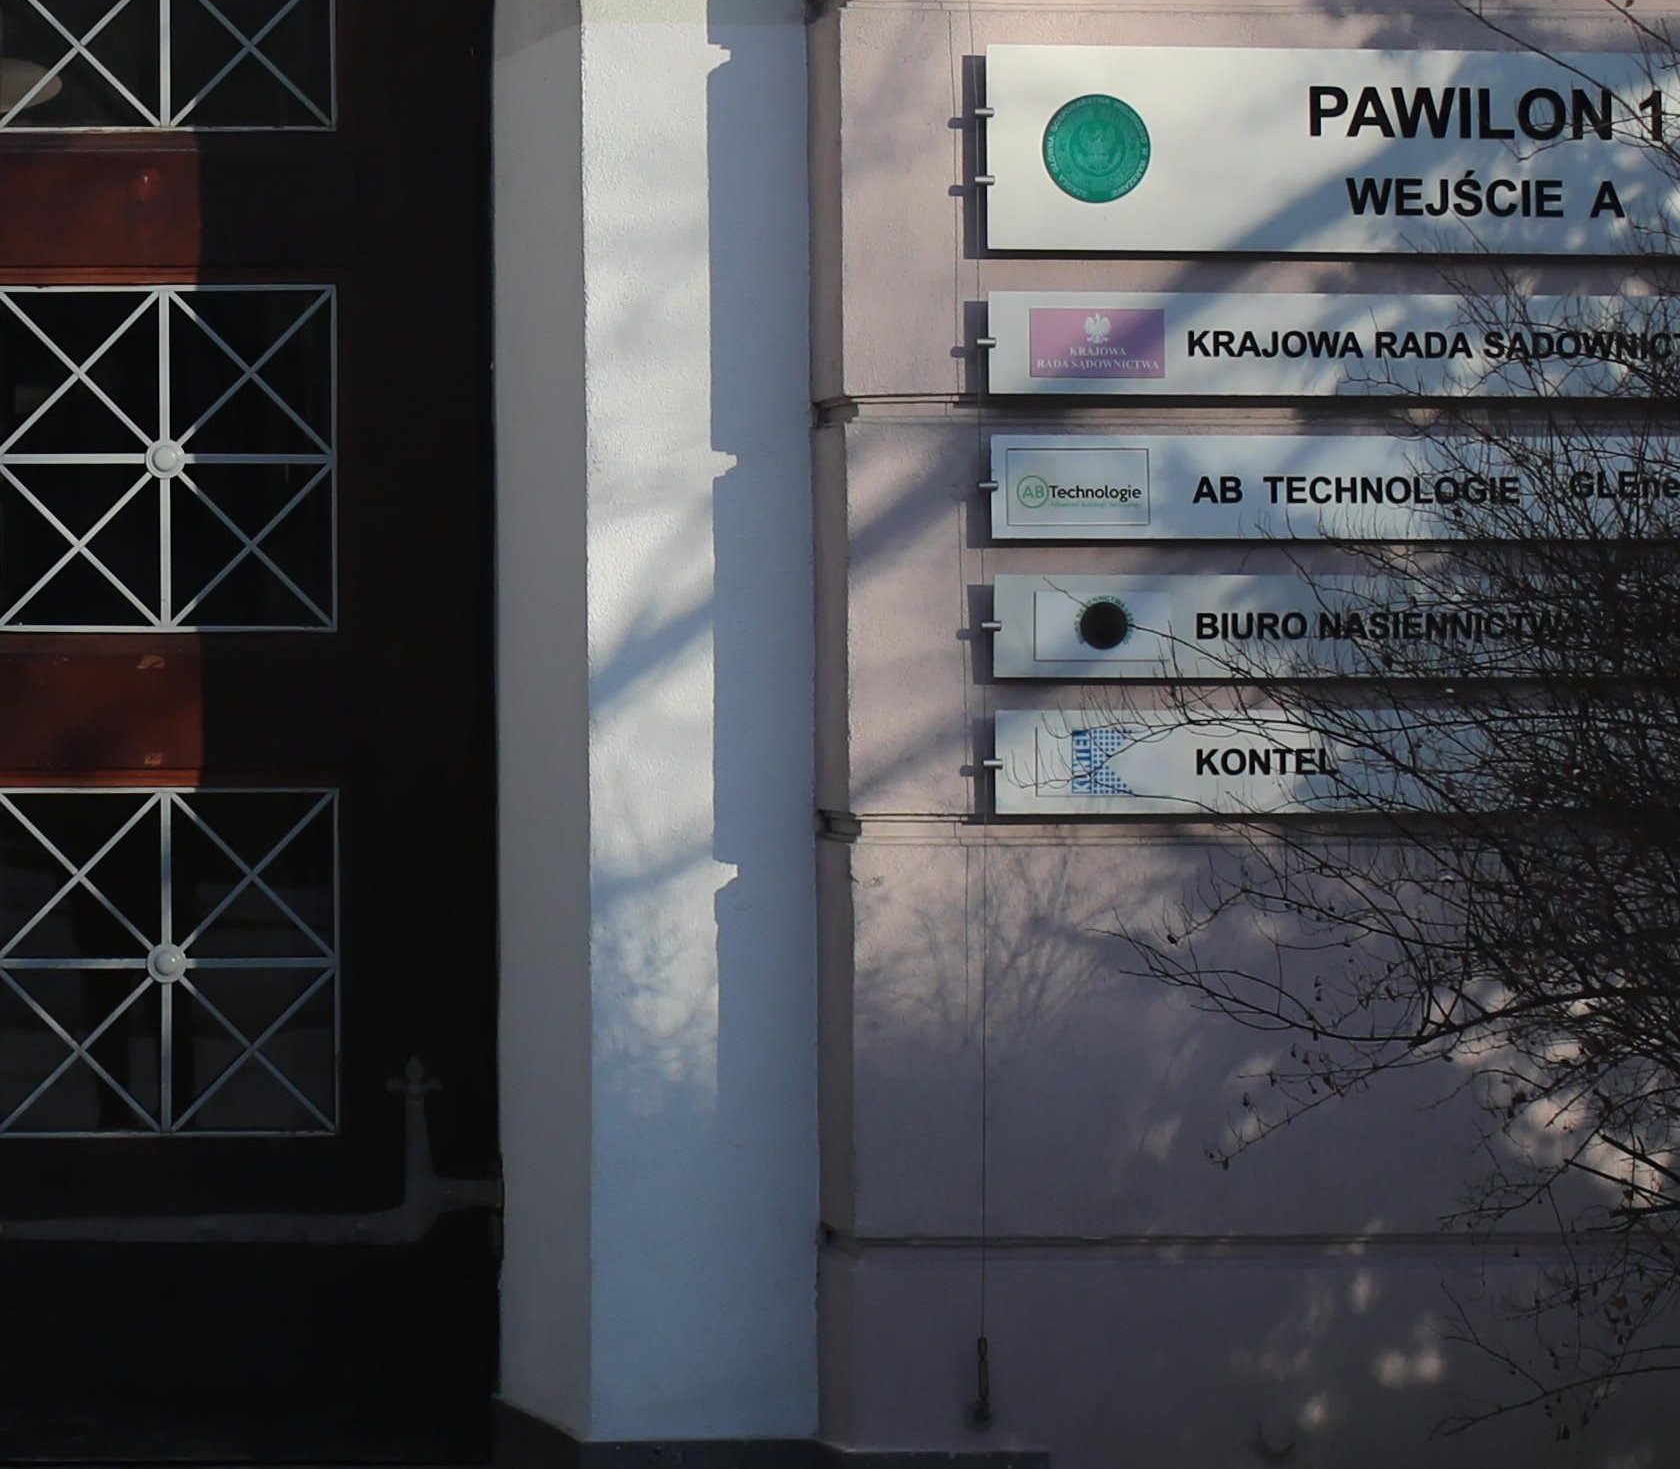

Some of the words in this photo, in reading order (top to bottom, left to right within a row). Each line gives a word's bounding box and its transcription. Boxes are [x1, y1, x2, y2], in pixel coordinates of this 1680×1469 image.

[1309, 86, 1612, 141] PAWILON
[1639, 90, 1663, 142] 1
[1346, 170, 1564, 218] WEJŚCIE
[1590, 181, 1625, 218] A
[1069, 346, 1127, 356] KRAJOWA
[1186, 330, 1364, 359] KRAJOWA
[1375, 331, 1473, 360] RADA
[1037, 359, 1069, 369] RADA
[1049, 485, 1142, 503] Technologie
[1192, 476, 1244, 505] AB
[1263, 476, 1522, 505] TECHNOLOGIE
[1195, 611, 1307, 640] BIURO
[1196, 748, 1338, 777] KONTEL
